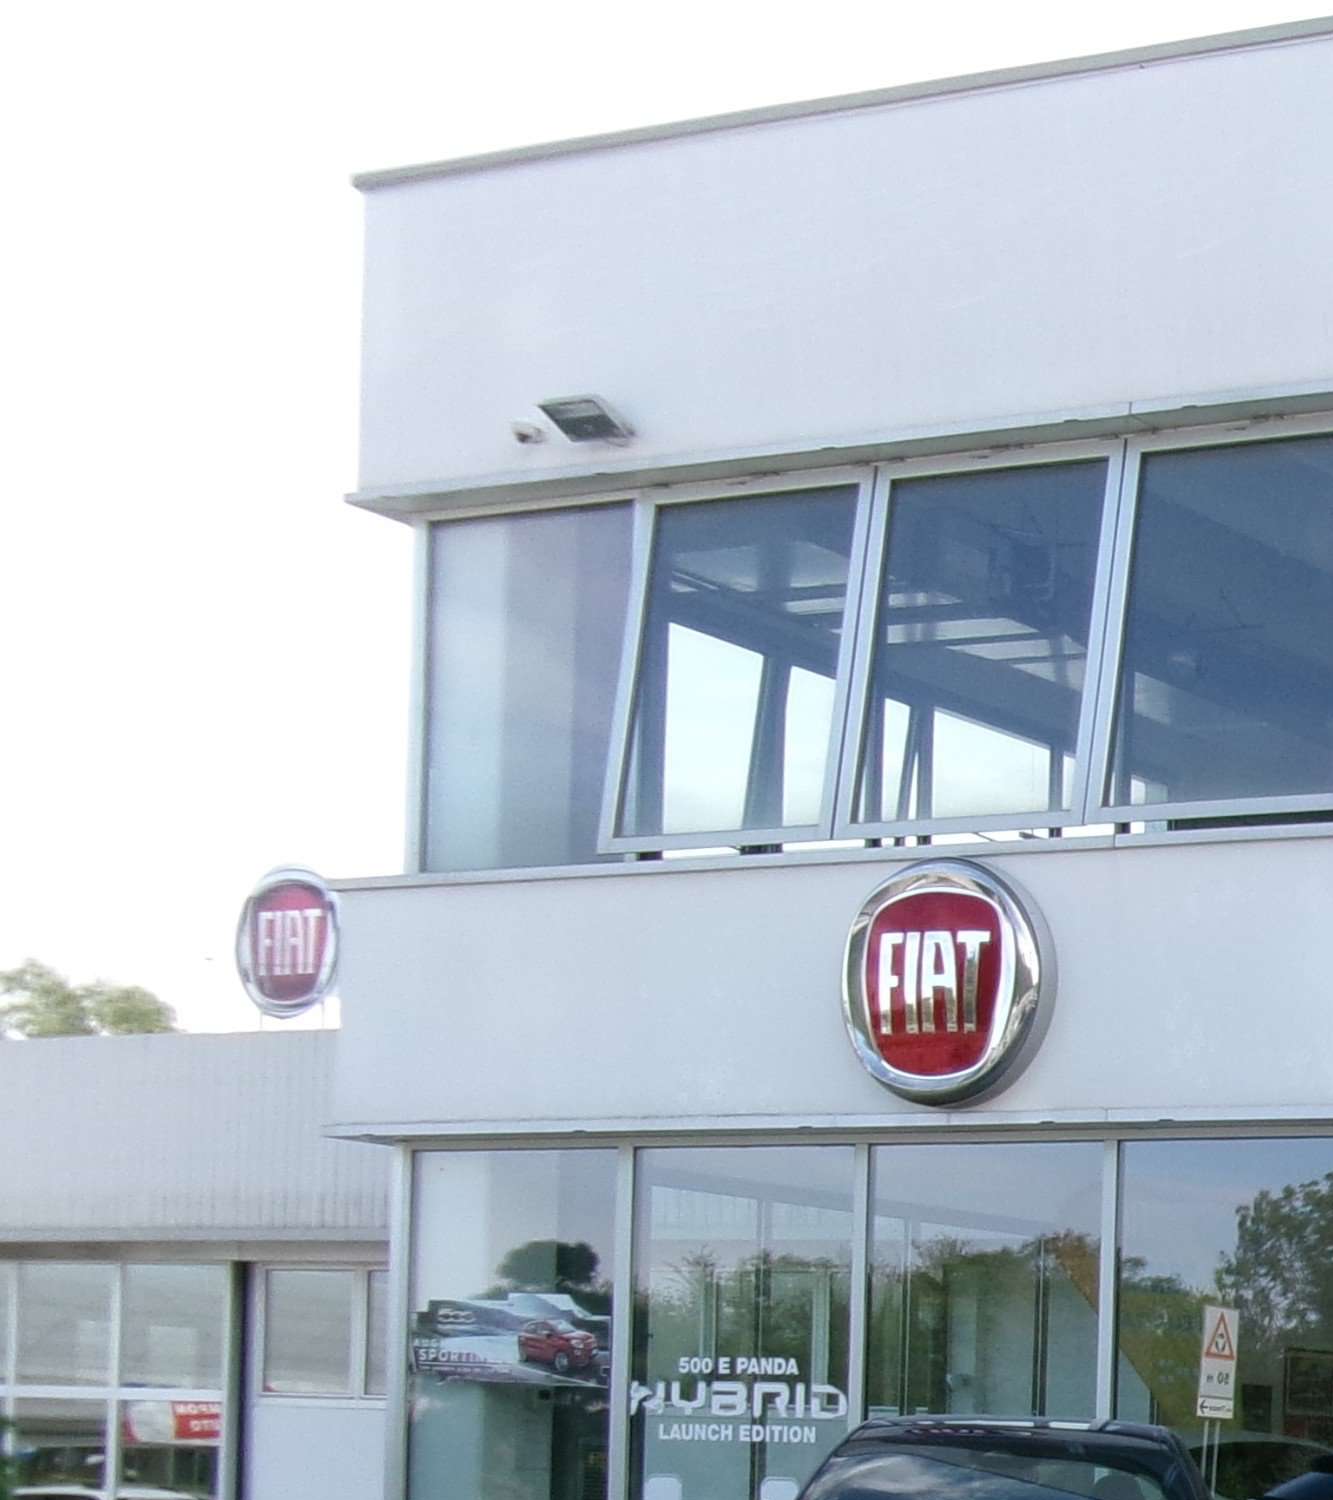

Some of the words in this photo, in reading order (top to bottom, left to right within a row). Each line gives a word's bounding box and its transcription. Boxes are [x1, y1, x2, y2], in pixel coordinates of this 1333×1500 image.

[257, 908, 323, 976] FIAT
[878, 930, 991, 1035] FIAT
[678, 1356, 713, 1375] 500
[718, 1357, 731, 1374] E
[736, 1357, 800, 1376] PANDA
[629, 1380, 848, 1419] HYBRID
[659, 1423, 733, 1442] LAUNCH
[739, 1424, 817, 1443] EDITION
